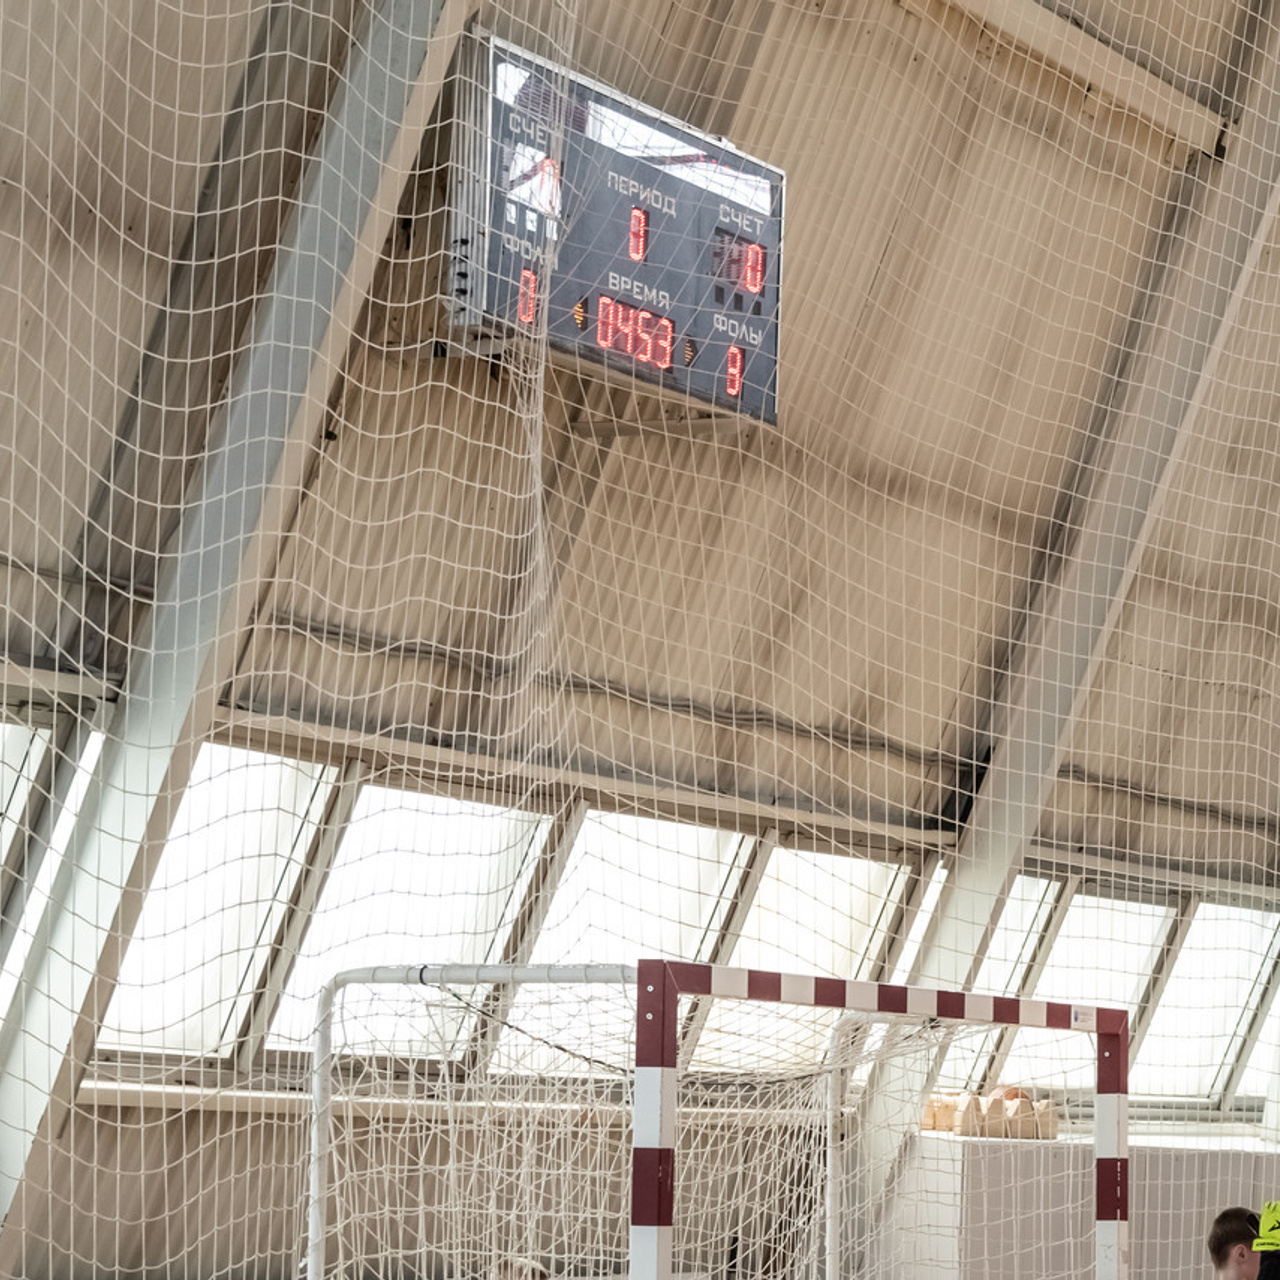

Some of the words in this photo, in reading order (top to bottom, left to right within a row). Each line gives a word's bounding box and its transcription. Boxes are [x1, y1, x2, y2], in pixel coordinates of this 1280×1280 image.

[607, 170, 677, 218] ПЕРИОД
[719, 203, 765, 236] СЧЕТ
[608, 272, 670, 311] ВРЕМЯ
[713, 313, 763, 346] ФОЛЫ
